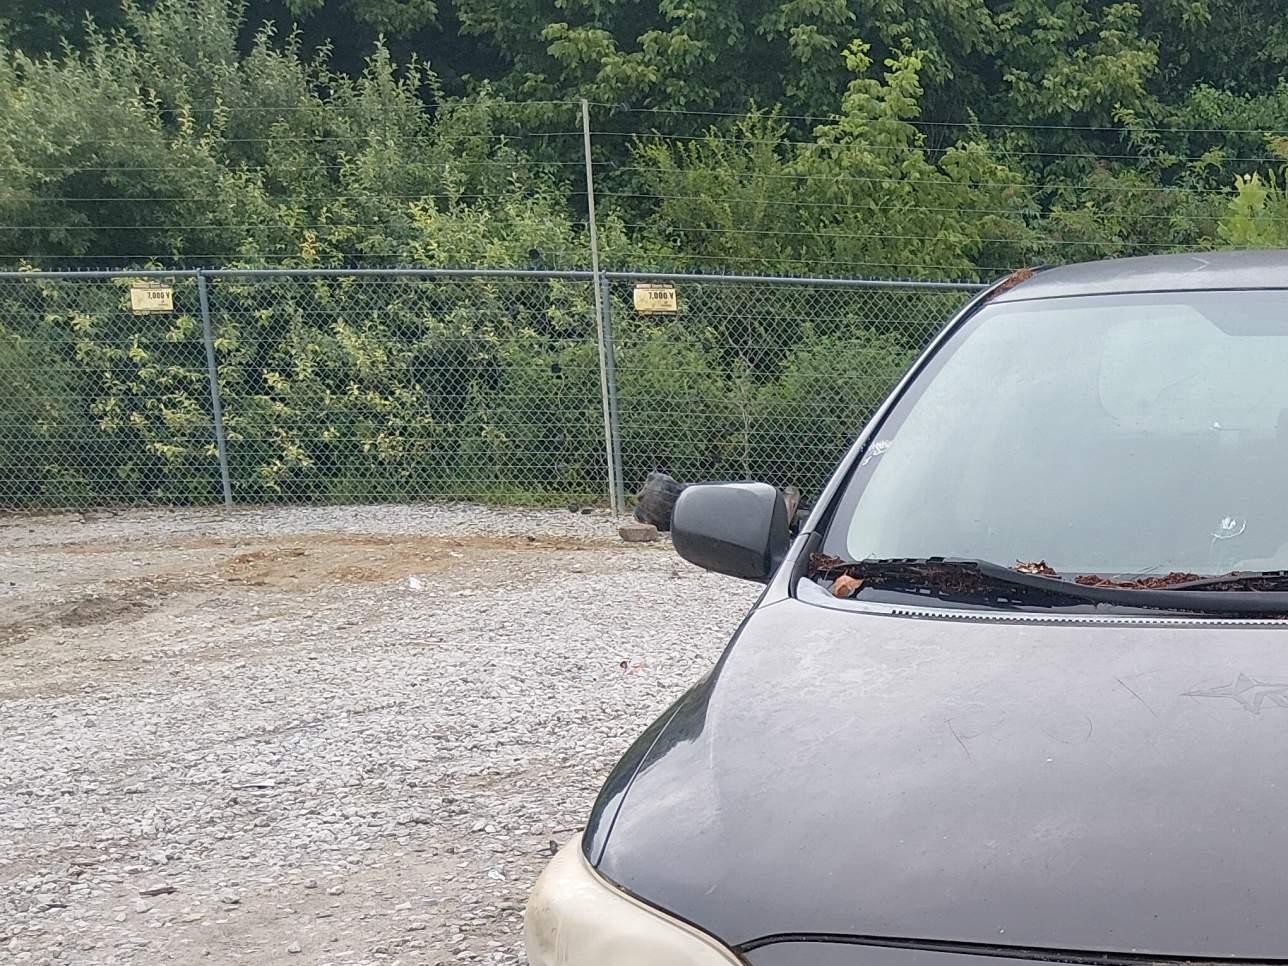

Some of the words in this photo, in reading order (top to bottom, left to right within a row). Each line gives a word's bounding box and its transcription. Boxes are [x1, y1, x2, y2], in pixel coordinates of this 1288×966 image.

[147, 291, 165, 300] 7,000
[648, 291, 668, 300] 7,000
[669, 291, 674, 299] V
